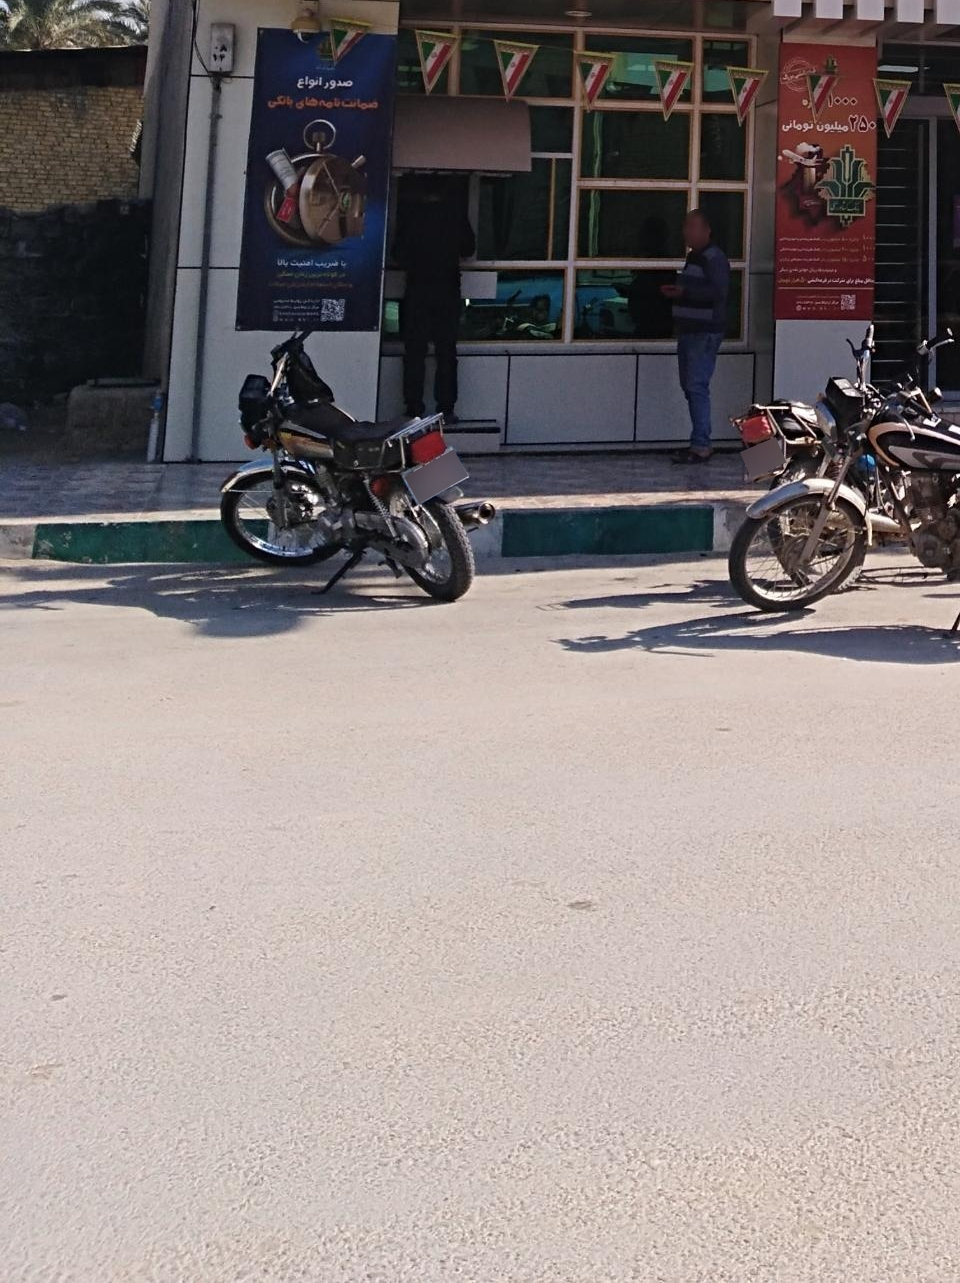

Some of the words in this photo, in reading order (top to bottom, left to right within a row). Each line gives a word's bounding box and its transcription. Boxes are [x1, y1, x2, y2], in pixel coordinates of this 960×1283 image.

[296, 75, 323, 90] انواع
[323, 78, 354, 90] صدور
[267, 94, 294, 109] بانکی
[782, 119, 814, 132] تومانی
[816, 120, 849, 133] میلیون
[848, 113, 877, 133] ۲۵۰
[277, 258, 289, 268] بالا
[290, 260, 314, 268] امنیت
[314, 260, 339, 269] ضریب
